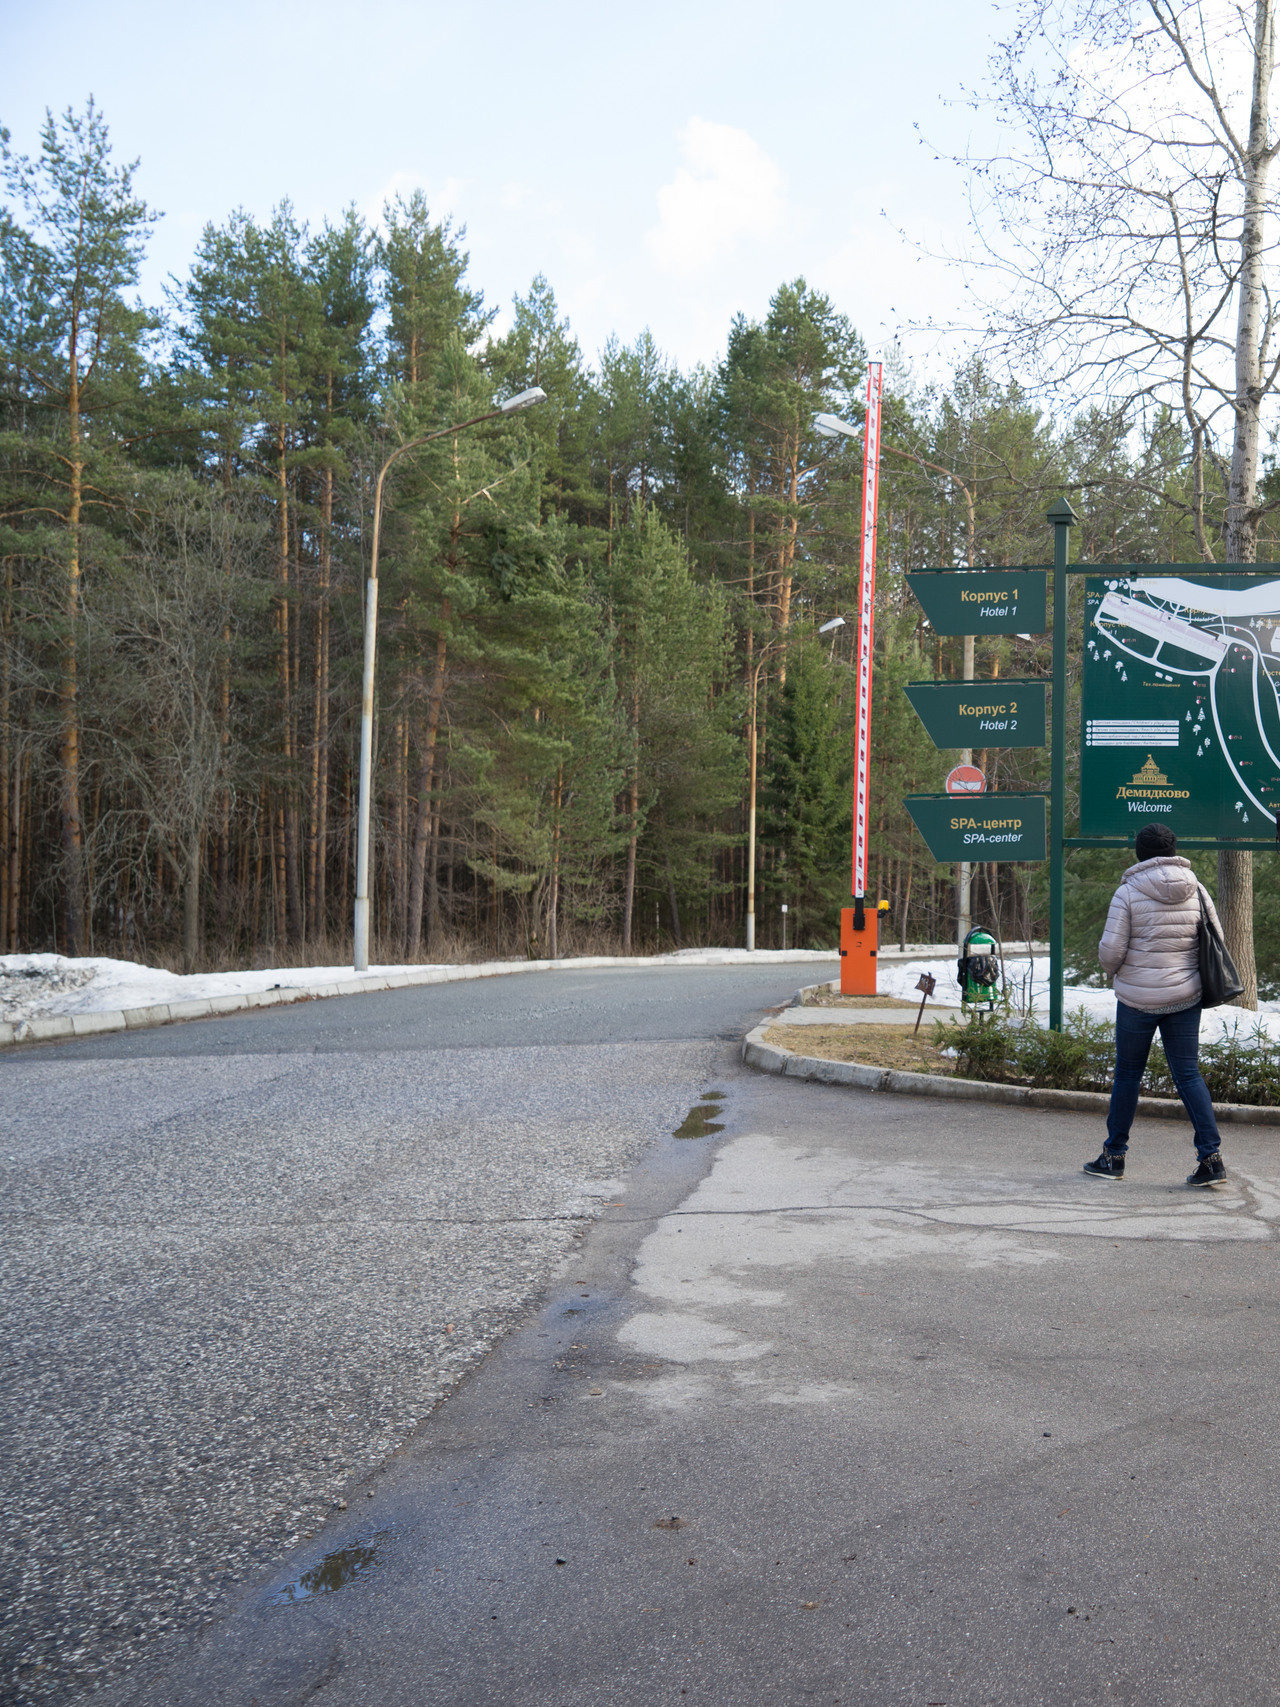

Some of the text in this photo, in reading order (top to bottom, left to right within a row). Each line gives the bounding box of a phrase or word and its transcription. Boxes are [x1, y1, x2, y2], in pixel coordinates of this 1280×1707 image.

[961, 588, 1019, 604] Корпус 1
[980, 605, 1017, 617] Hotel 1
[959, 701, 1018, 718] Корпус 2
[979, 719, 1018, 731] Hotel 2
[1116, 786, 1191, 800] Демидково
[1127, 800, 1173, 813] Welcome
[950, 817, 1022, 832] SPA-центр
[962, 832, 1023, 845] SPA-center
